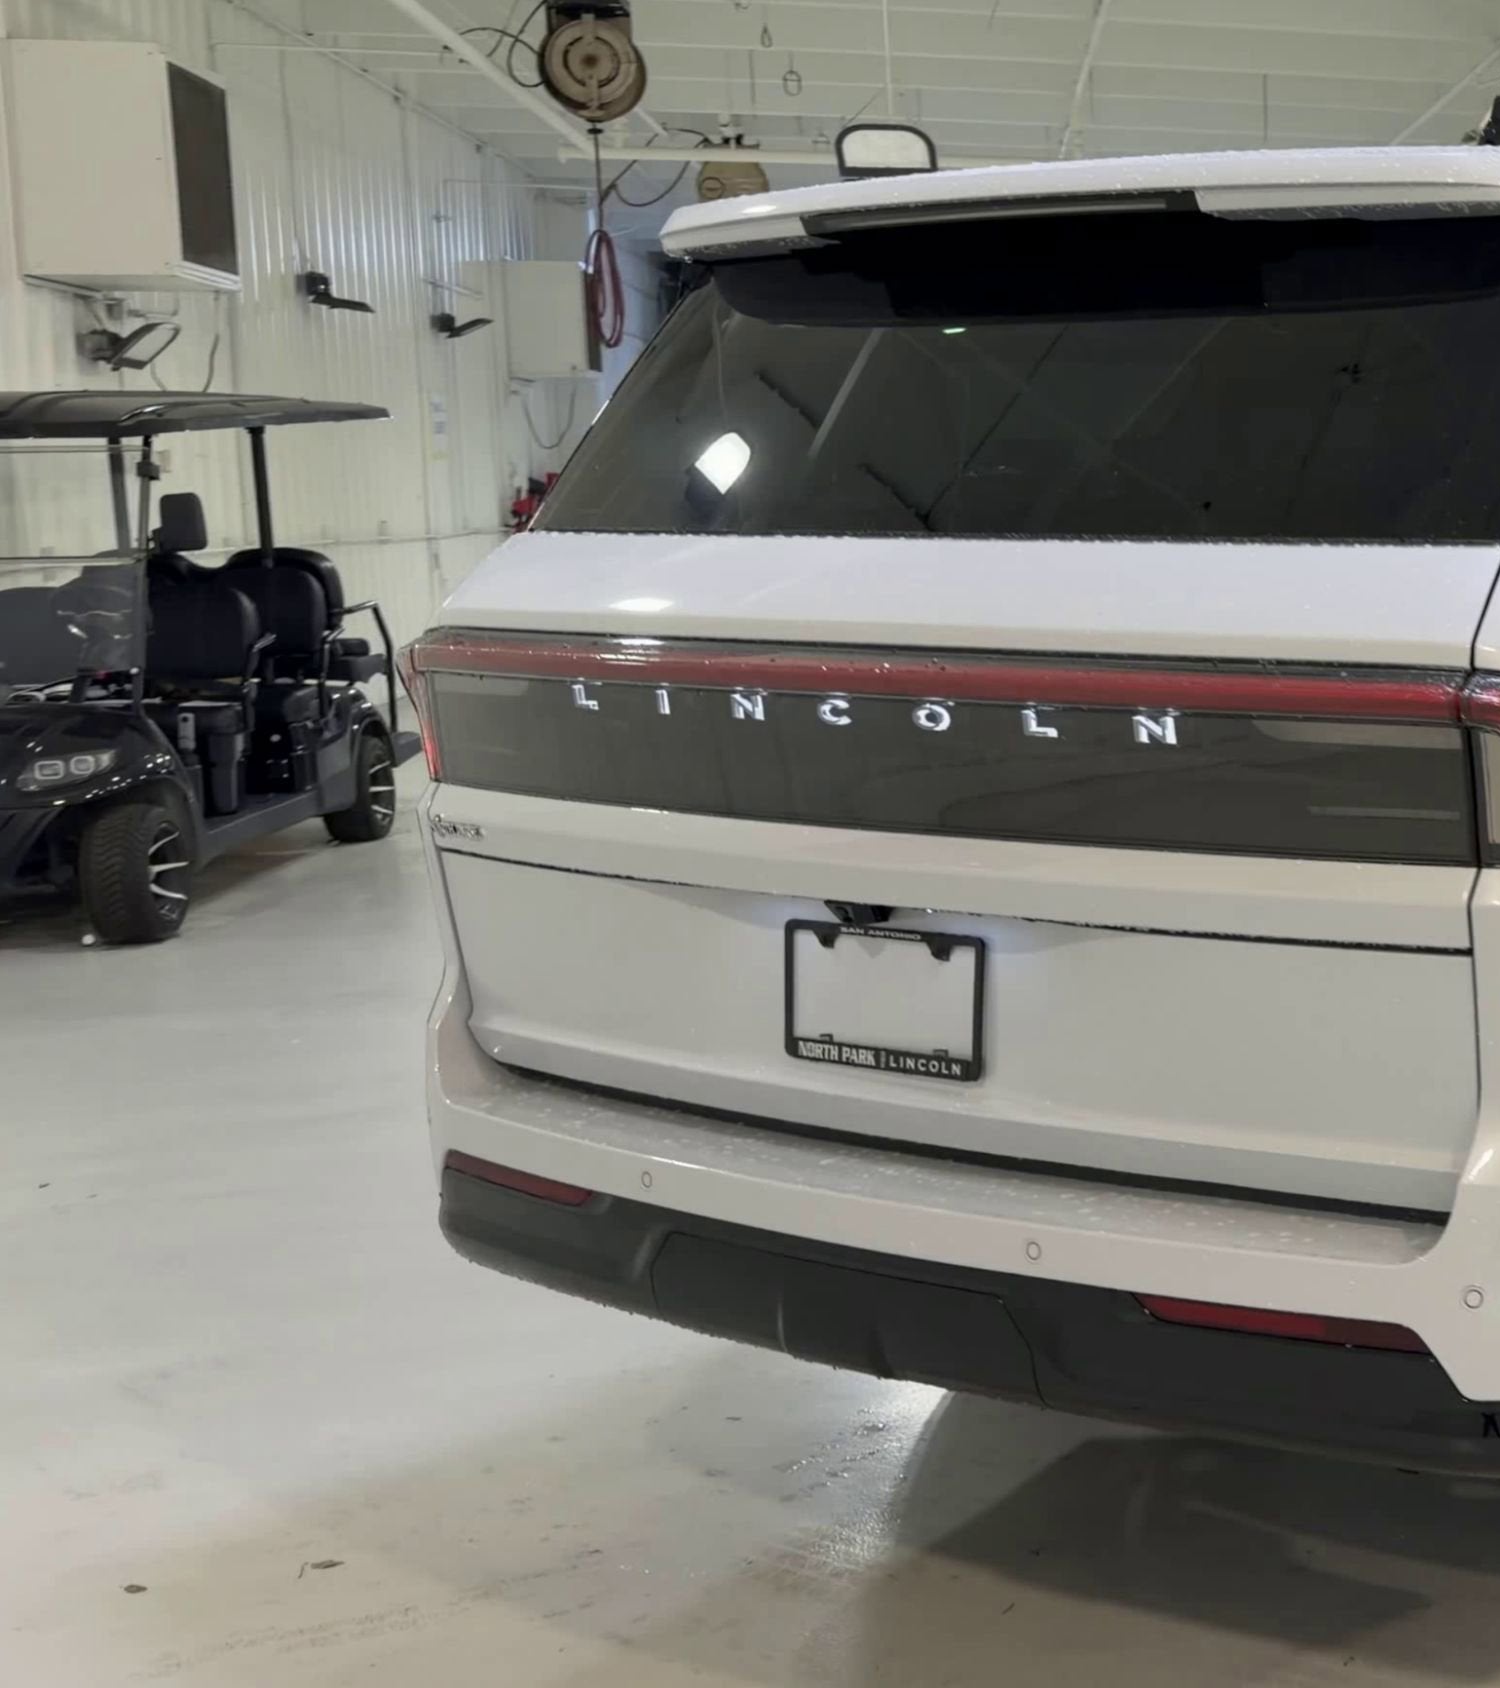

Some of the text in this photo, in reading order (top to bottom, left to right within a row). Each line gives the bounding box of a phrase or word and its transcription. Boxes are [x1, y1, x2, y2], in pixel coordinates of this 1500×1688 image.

[572, 681, 1180, 745] LINCOLN
[840, 926, 865, 935] SAN
[798, 1040, 838, 1061] NORTH
[841, 1046, 876, 1066] PARK
[889, 1054, 962, 1076] LINCOLN
